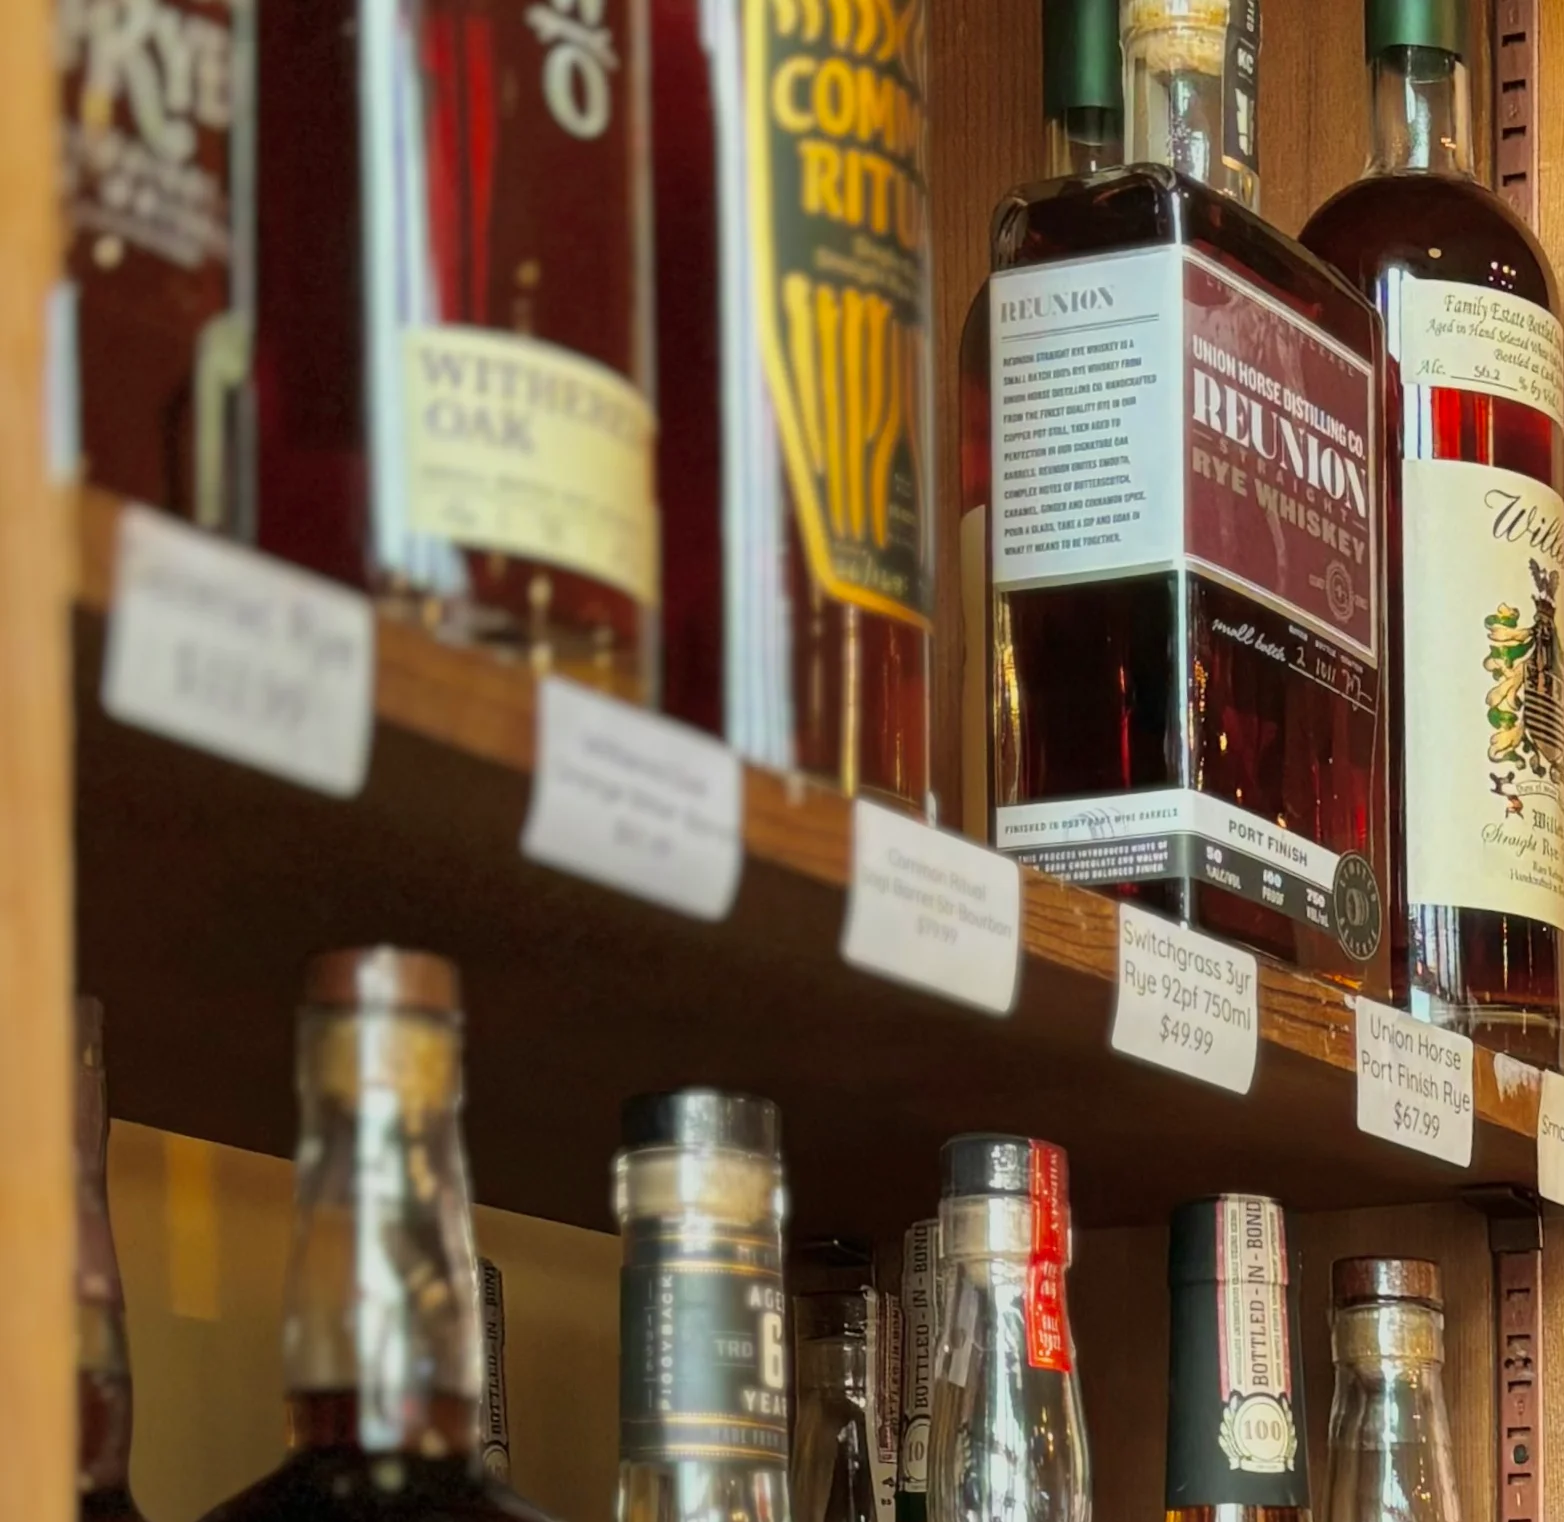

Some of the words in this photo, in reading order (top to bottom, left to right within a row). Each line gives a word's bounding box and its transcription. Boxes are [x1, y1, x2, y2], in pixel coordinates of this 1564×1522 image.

[1000, 287, 1114, 324] REUNION
[1426, 318, 1455, 336] Aged
[1456, 322, 1467, 335] in
[1445, 294, 1488, 325] Family
[1491, 302, 1526, 330] Estate
[1416, 359, 1446, 376] Alc.
[1494, 348, 1531, 370] Bottled
[1193, 334, 1236, 378] UNION
[1239, 362, 1282, 407] HORSE
[1283, 386, 1347, 448] DISTILLING
[1348, 429, 1366, 461] CO.
[422, 400, 536, 454] OAK
[1193, 367, 1367, 519] REUNION
[1192, 446, 1248, 498] RYE
[1254, 477, 1366, 566] WHISKEY
[1005, 821, 1047, 835] FINISHED
[1228, 819, 1264, 847] PORT
[1267, 835, 1308, 867] FINISH
[1481, 822, 1537, 858] Straight
[1205, 845, 1223, 864] 50
[1262, 868, 1282, 888] 100
[1123, 918, 1223, 982] Switchgrass
[1225, 951, 1252, 993] 3yr
[1124, 959, 1158, 997] Rye
[1161, 971, 1198, 1013] 92pf
[1203, 988, 1252, 1032] 750ml
[1159, 1012, 1215, 1057] $49.99
[1370, 1013, 1414, 1053] Union
[1418, 1033, 1462, 1071] Horse
[1361, 1050, 1393, 1083] Port
[1397, 1063, 1439, 1104] Finish
[1443, 1080, 1471, 1115] Rye
[1393, 1100, 1441, 1140] $67.99
[913, 1225, 928, 1272] BOND
[1246, 1200, 1264, 1251] BOND
[1248, 1265, 1265, 1285] IN
[1250, 1299, 1270, 1387] BOTTLED
[914, 1336, 930, 1409] BOTTLED
[1243, 1418, 1282, 1441] 100
